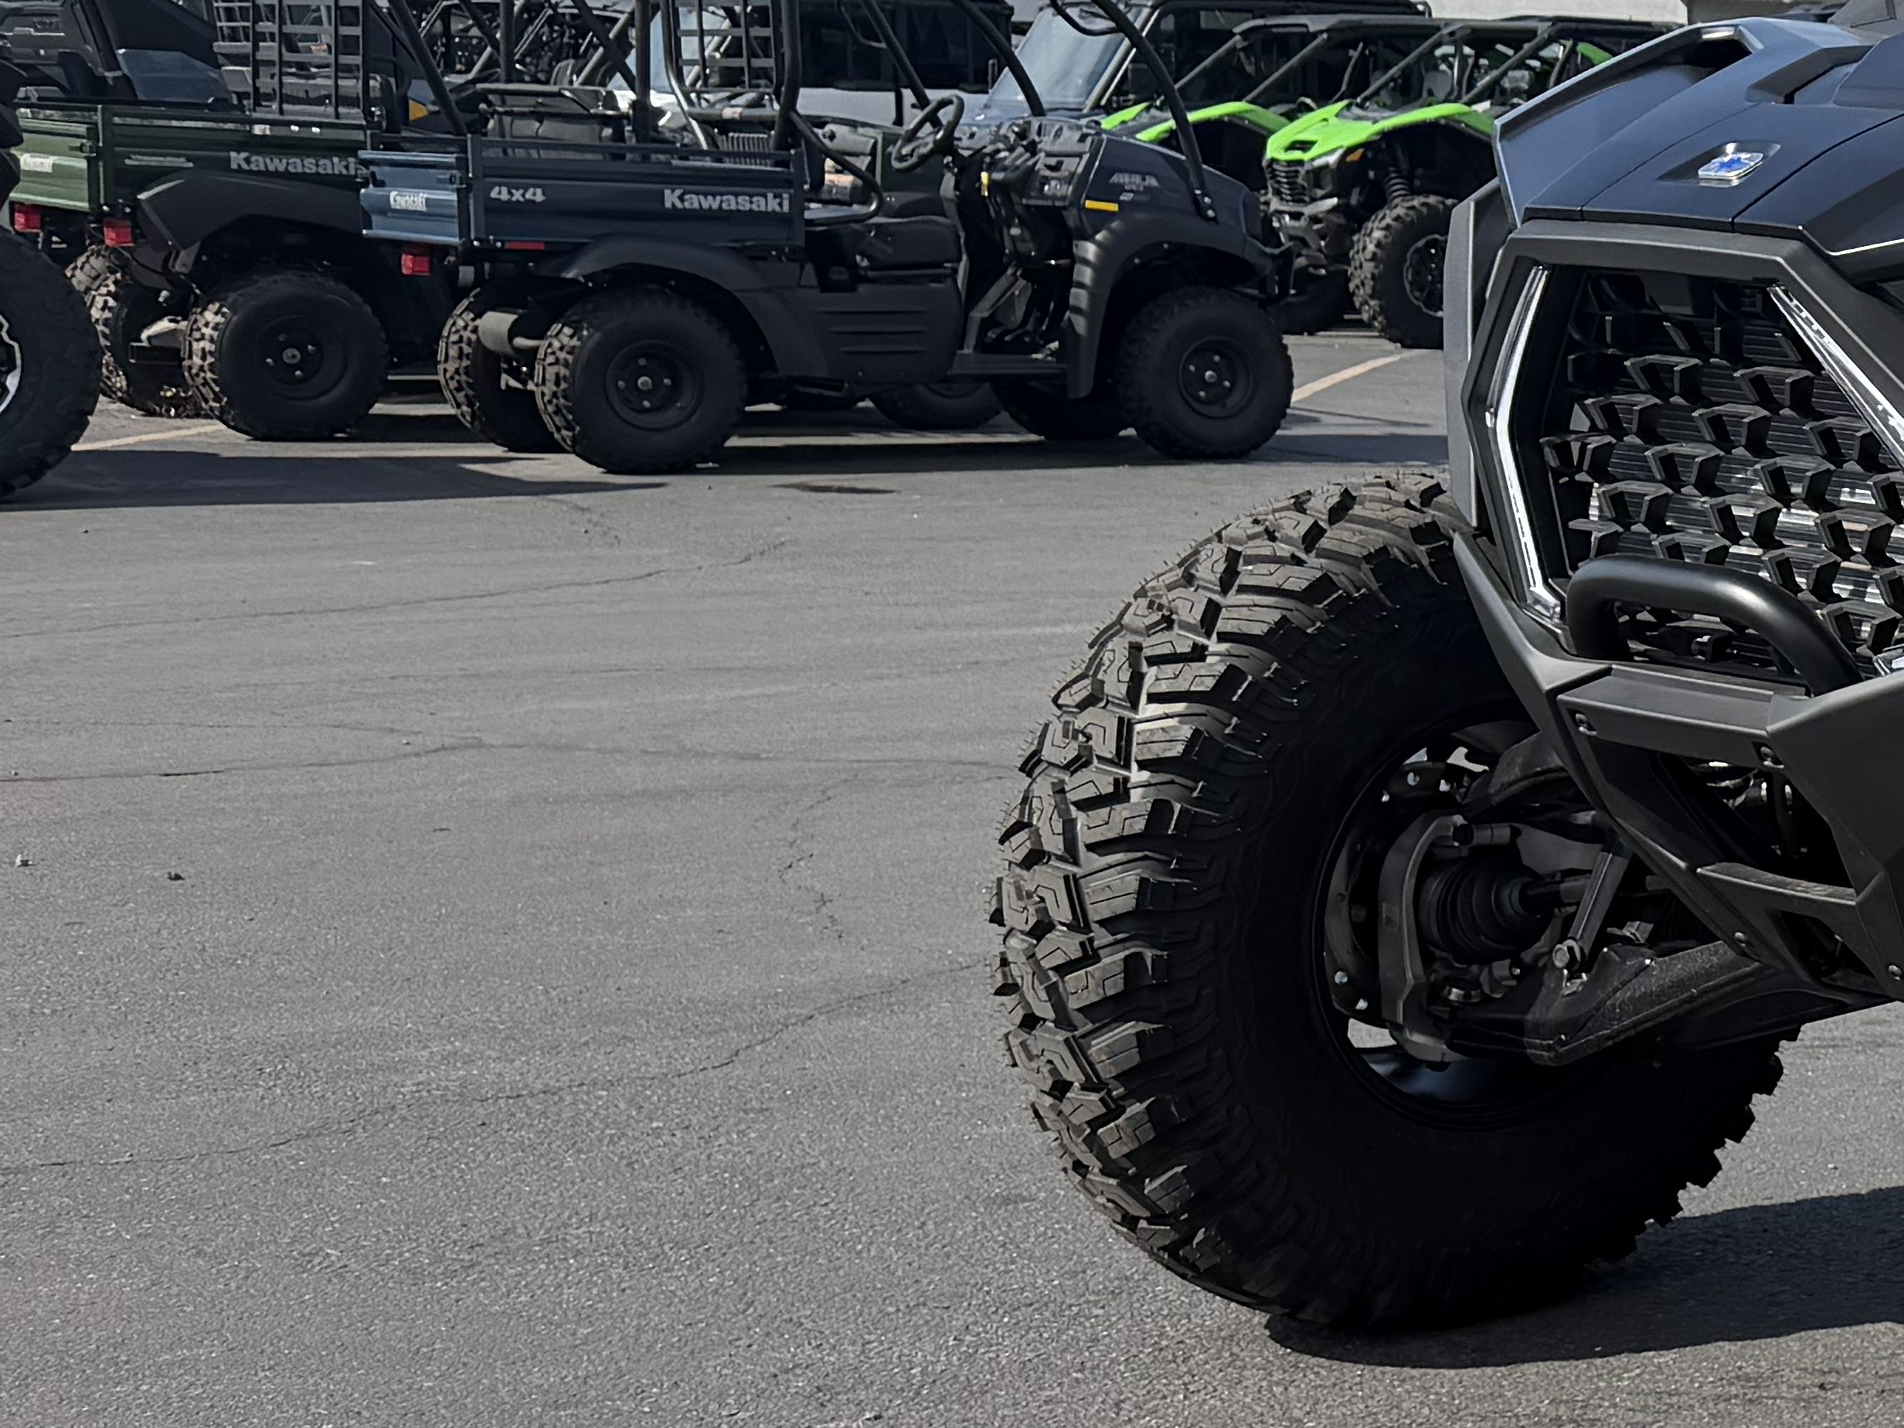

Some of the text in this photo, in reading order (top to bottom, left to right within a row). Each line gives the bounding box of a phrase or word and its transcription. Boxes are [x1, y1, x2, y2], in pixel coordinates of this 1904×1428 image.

[229, 151, 356, 175] Kawasaki
[490, 185, 546, 202] 4x4
[663, 188, 790, 213] Kawasaki
